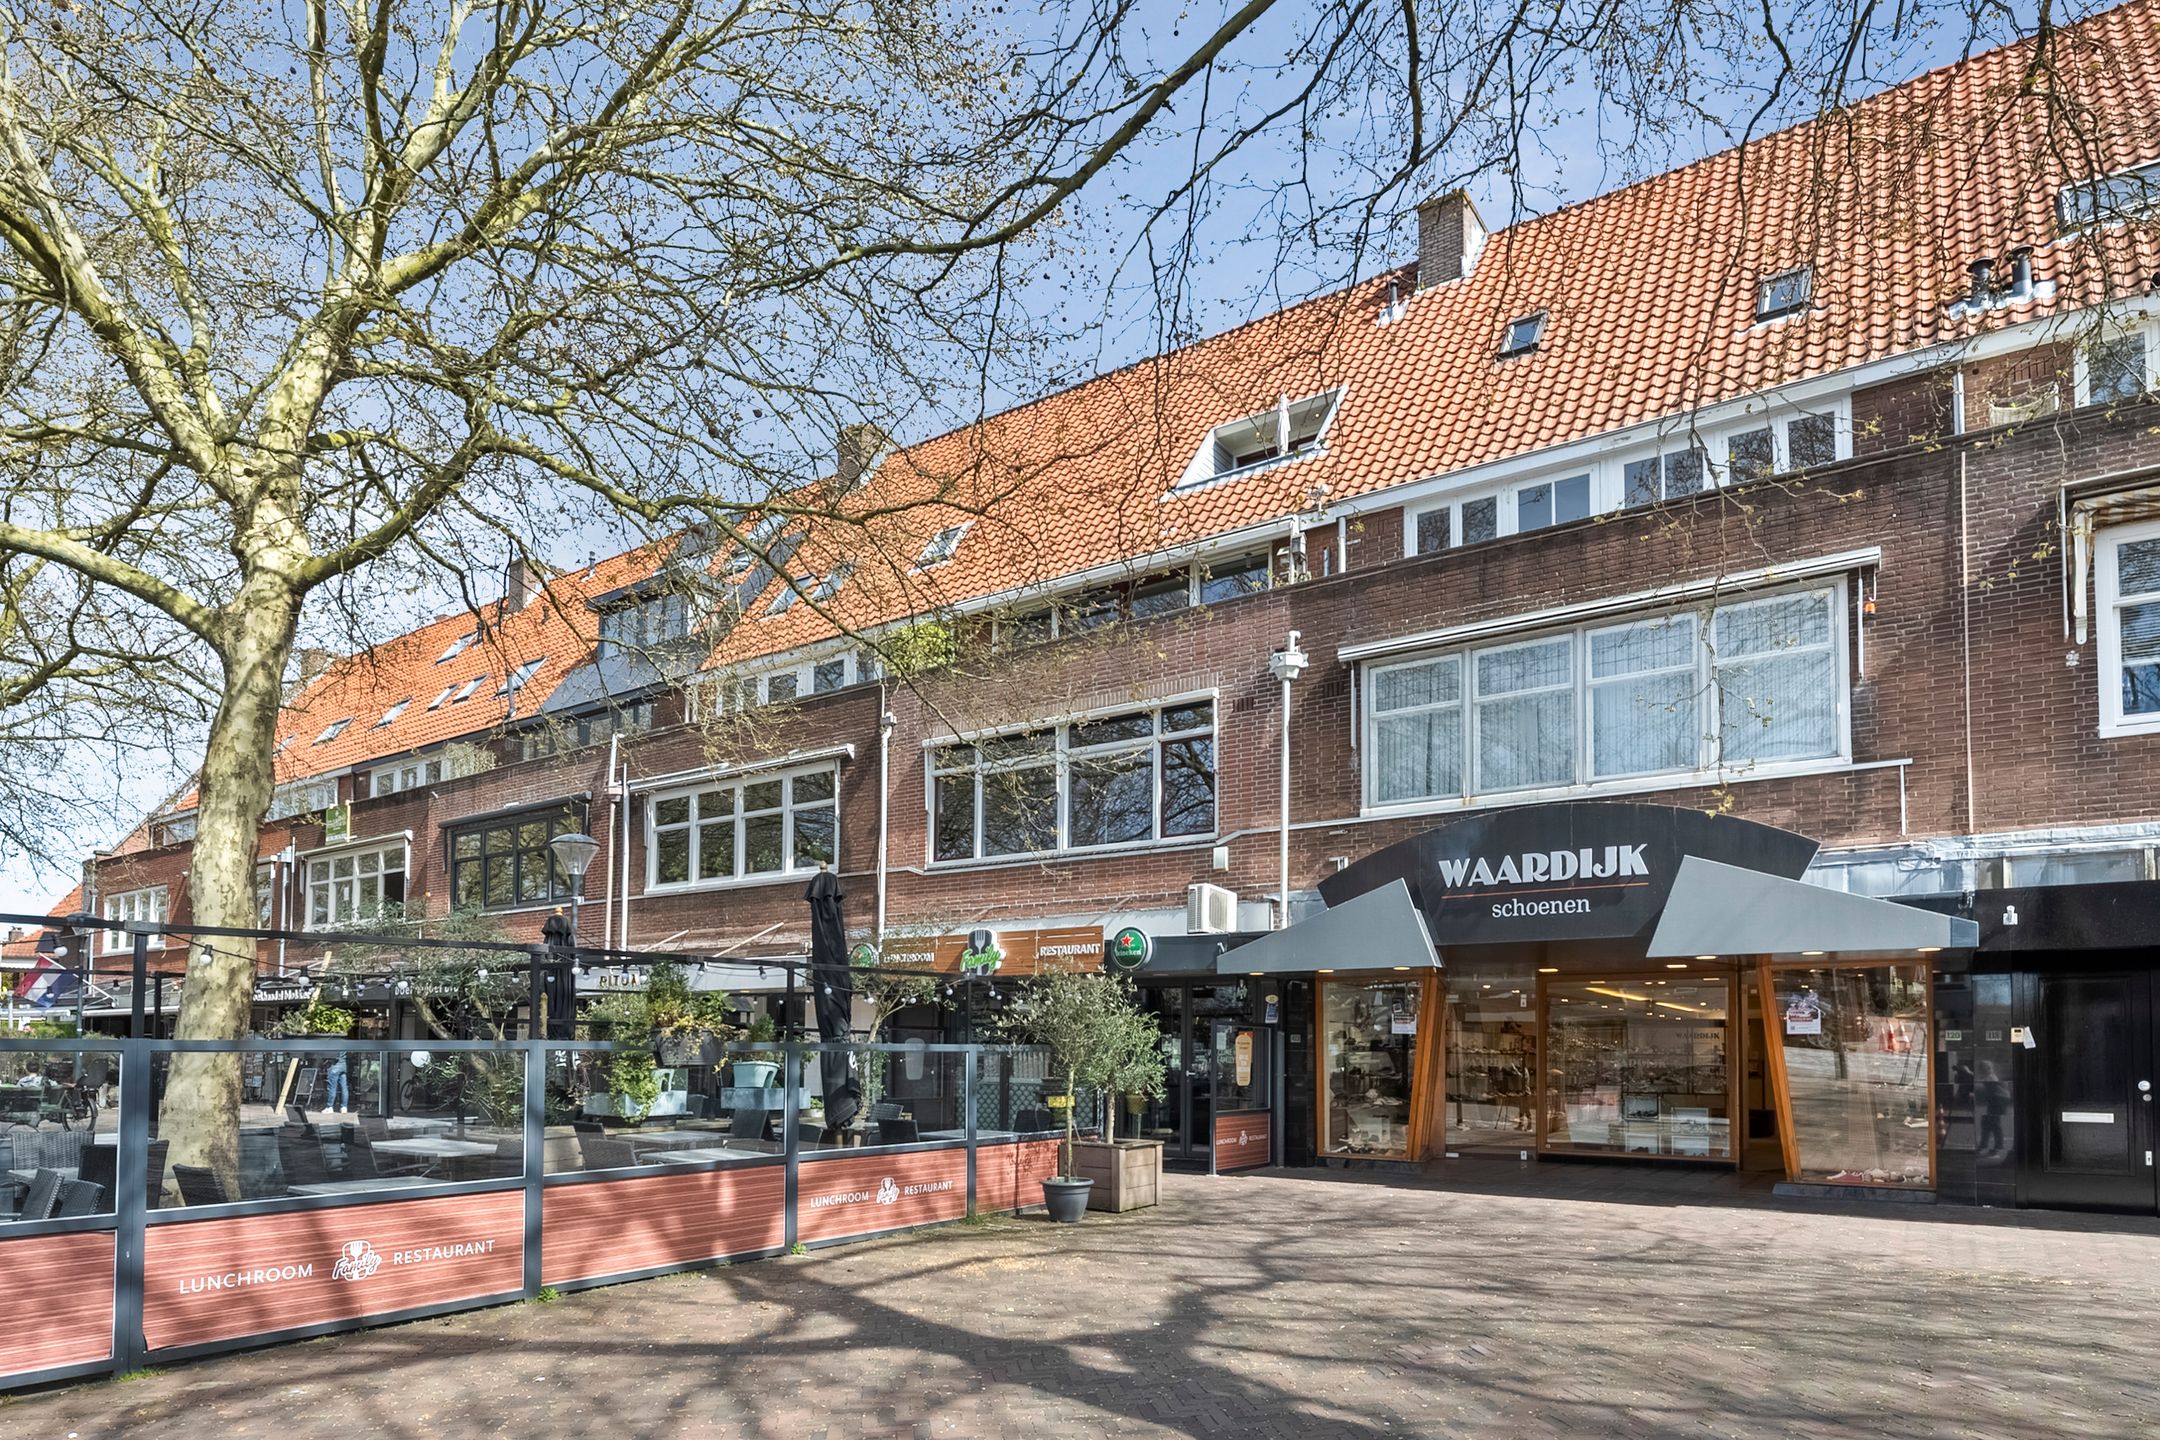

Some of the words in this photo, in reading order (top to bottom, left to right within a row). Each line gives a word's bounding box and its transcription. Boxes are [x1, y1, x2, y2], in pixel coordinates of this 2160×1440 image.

[1438, 843, 1649, 889] WAARDIJK
[1491, 898, 1591, 918] schoenen
[960, 943, 1001, 972] Family
[1039, 943, 1101, 956] RESTAURANT
[1946, 1031, 1960, 1039] 120
[811, 1191, 869, 1209] LUNCHROOM
[904, 1180, 953, 1196] RESTAURANT
[179, 1263, 313, 1295] LUNCHROOM
[332, 1250, 382, 1280] Family
[393, 1240, 496, 1265] RESTAURANT
